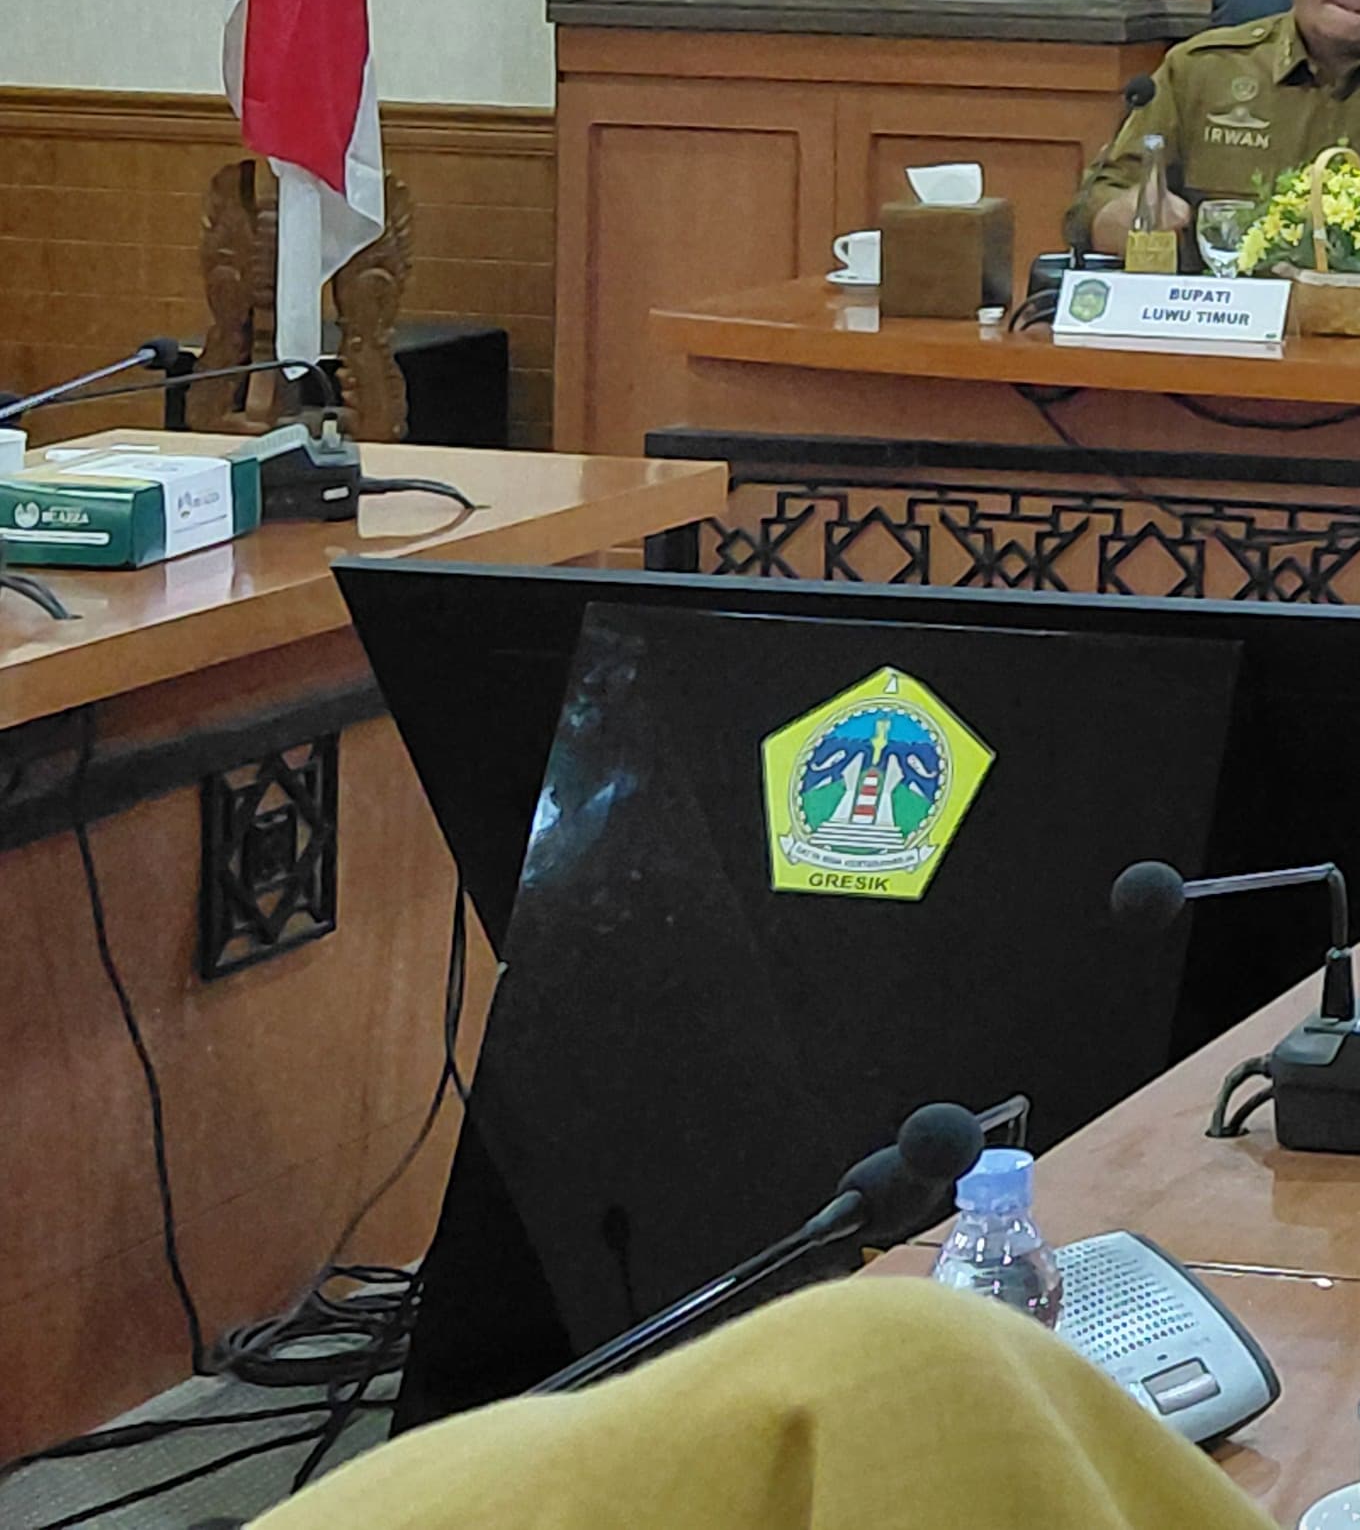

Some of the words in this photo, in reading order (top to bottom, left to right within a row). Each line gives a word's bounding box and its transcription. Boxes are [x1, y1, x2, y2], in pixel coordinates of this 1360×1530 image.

[1203, 126, 1271, 150] IRWAN
[1168, 288, 1231, 304] BUPATI
[1142, 307, 1191, 322] LUWU
[1196, 311, 1250, 326] TIMUR
[809, 872, 890, 892] GRESIK
